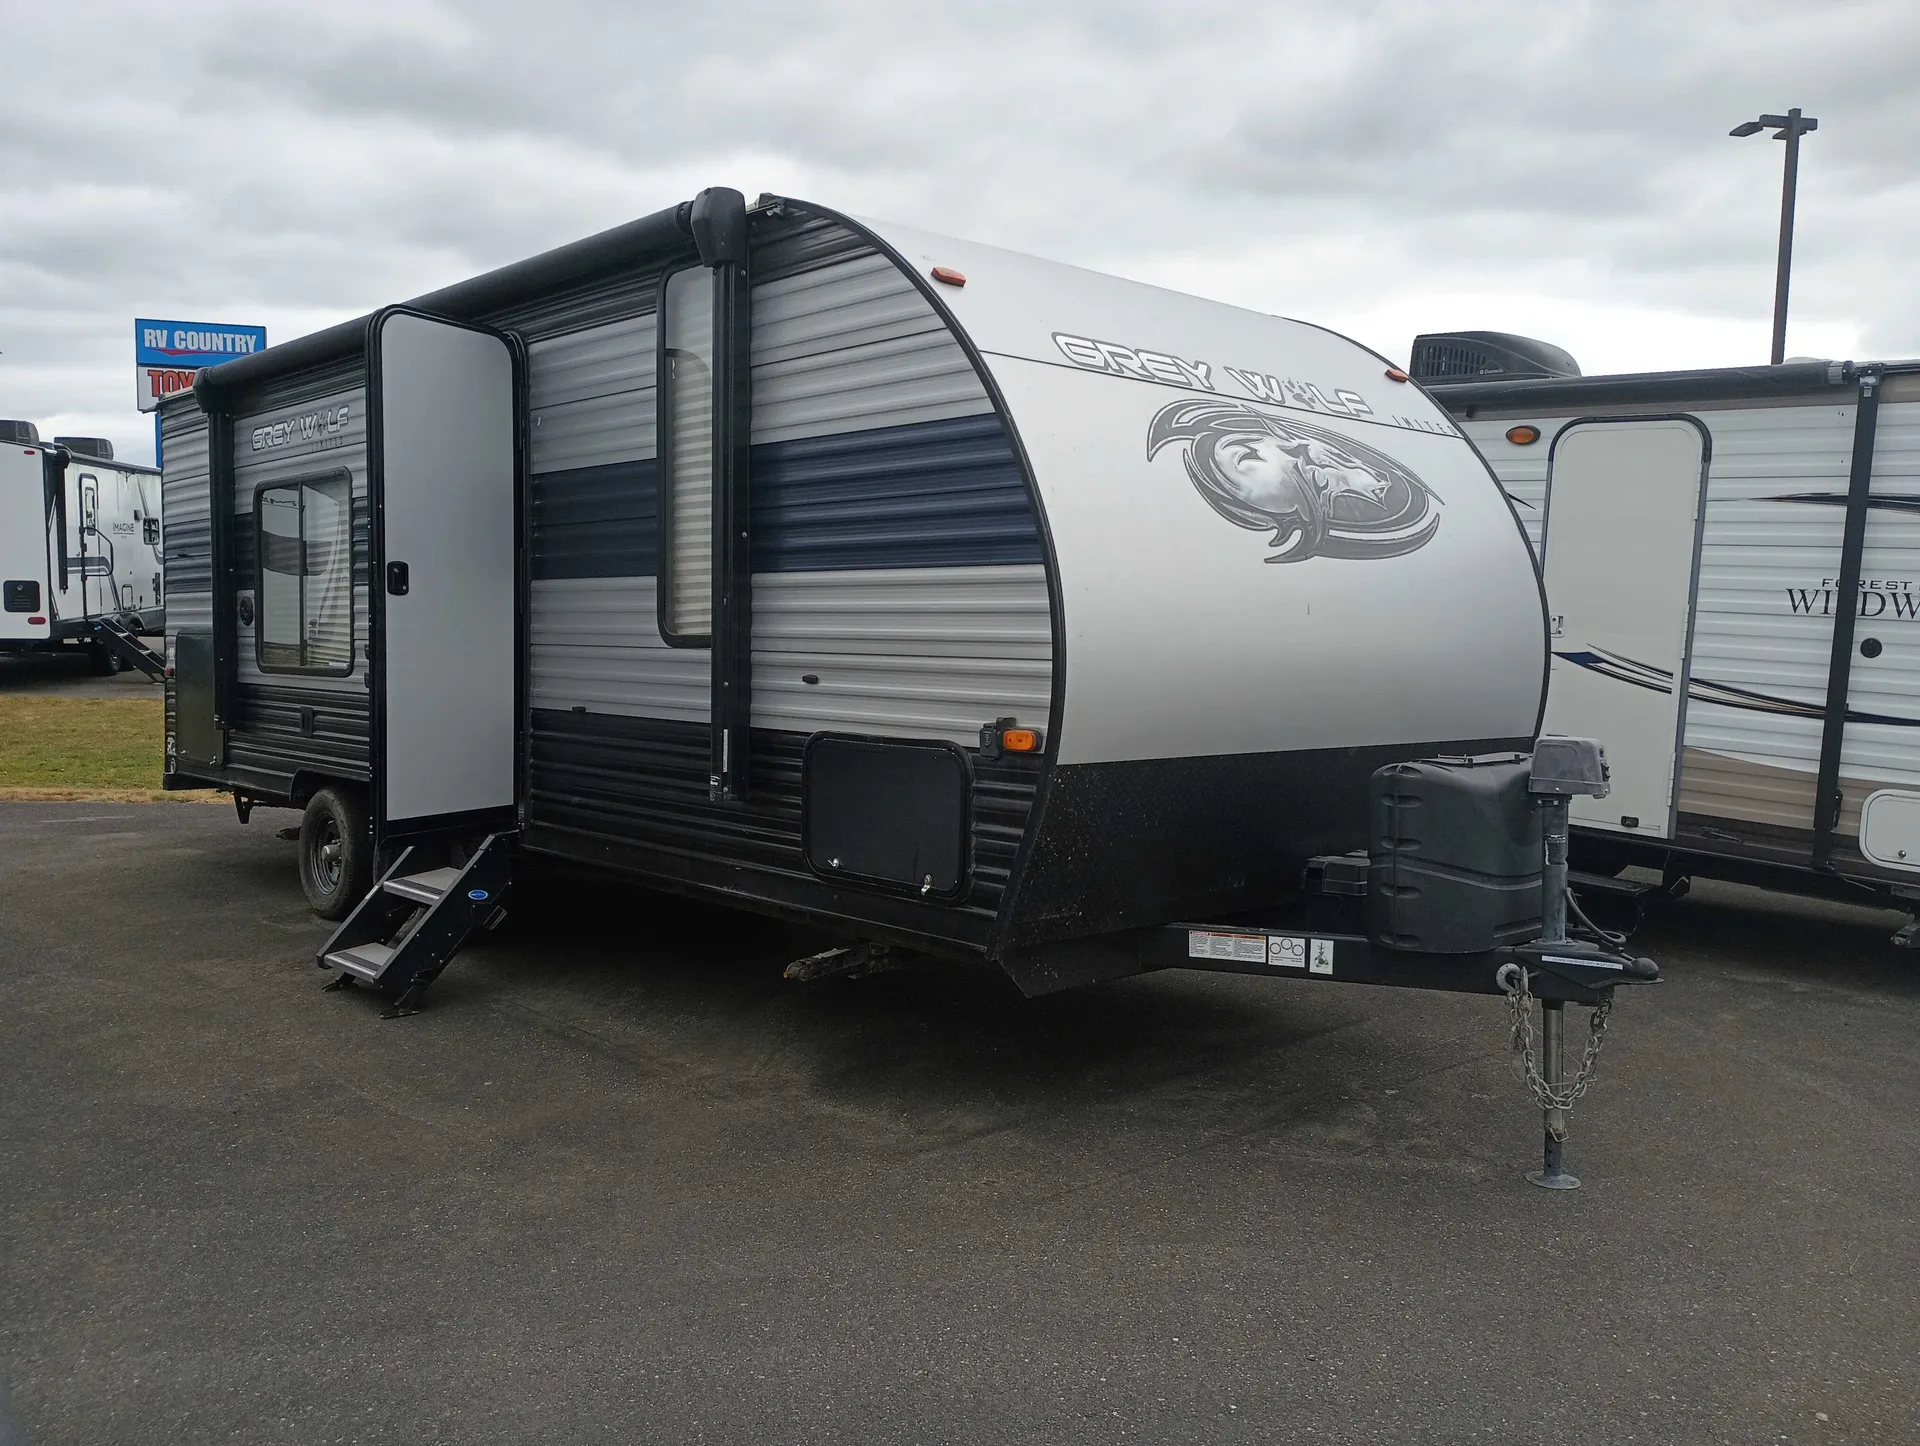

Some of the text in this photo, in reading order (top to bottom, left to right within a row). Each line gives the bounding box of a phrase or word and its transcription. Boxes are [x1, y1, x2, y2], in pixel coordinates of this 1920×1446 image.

[144, 329, 257, 353] RV COUNTRY
[1051, 332, 1216, 391] GREY
[251, 419, 295, 451] GREY
